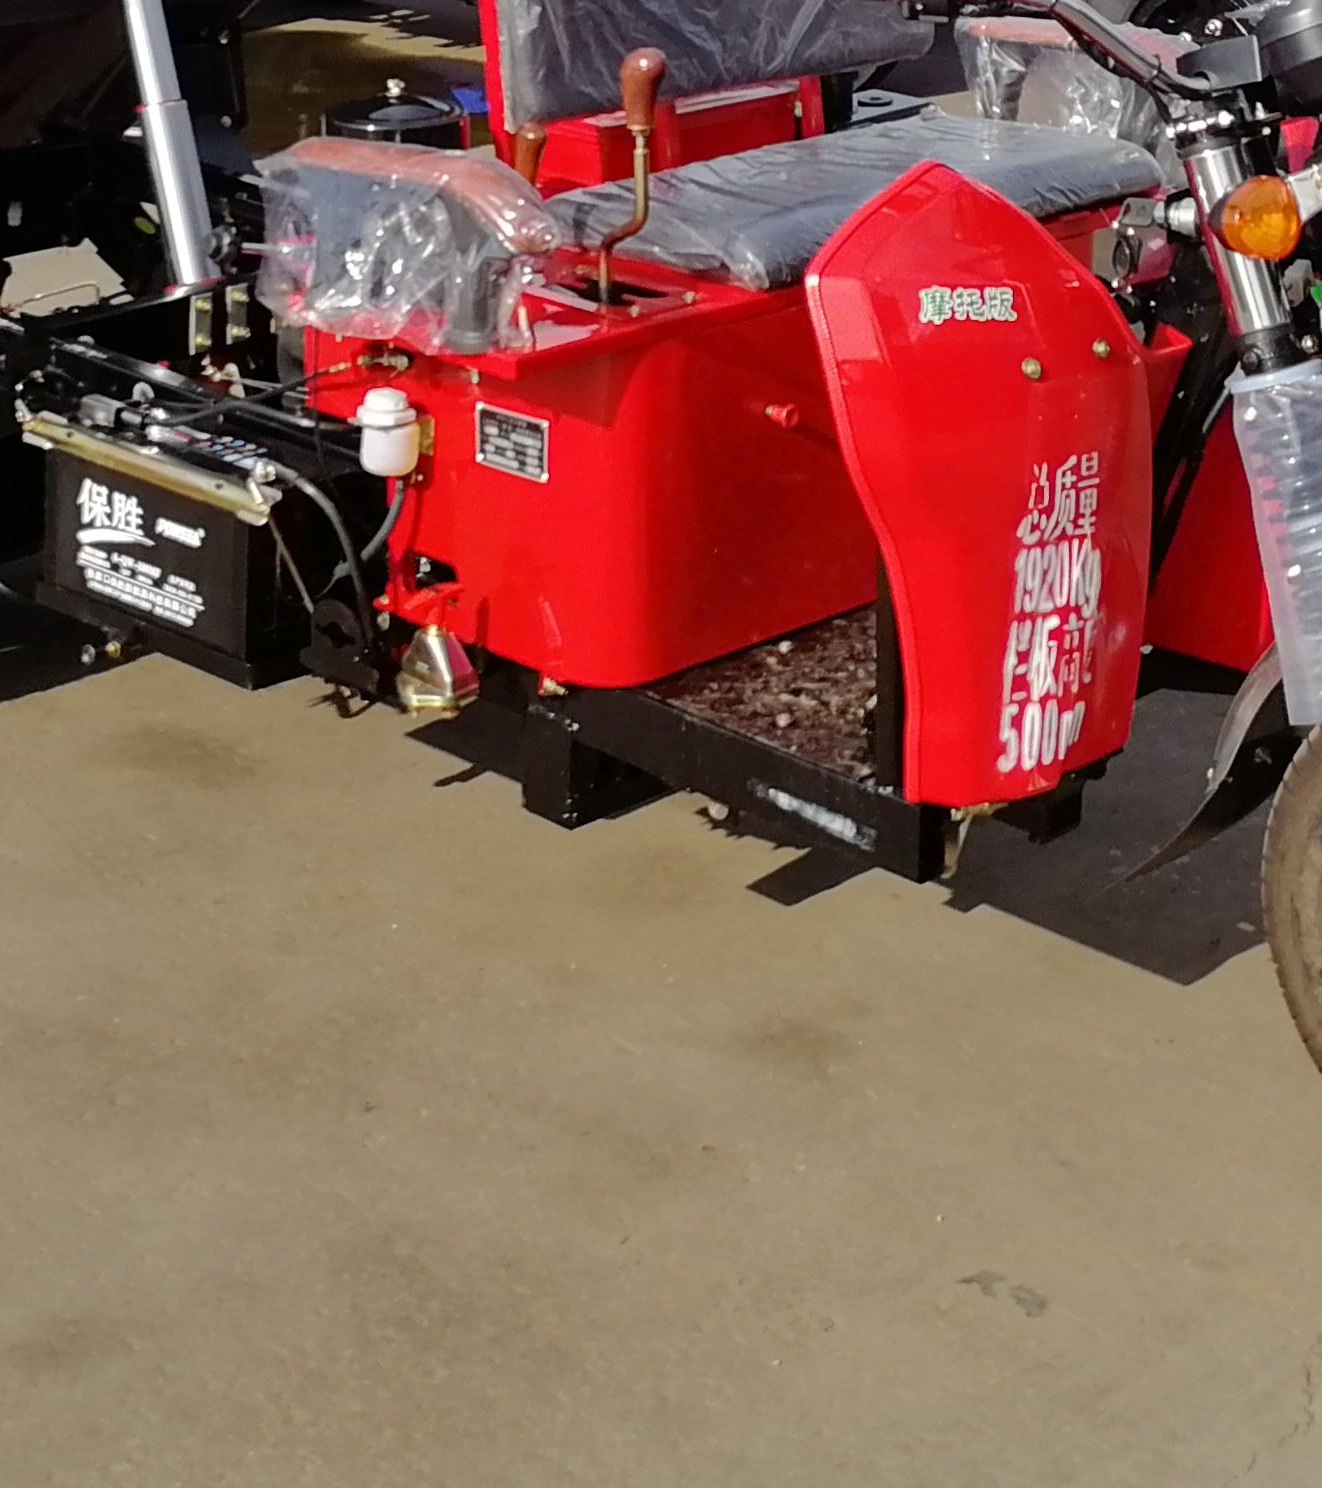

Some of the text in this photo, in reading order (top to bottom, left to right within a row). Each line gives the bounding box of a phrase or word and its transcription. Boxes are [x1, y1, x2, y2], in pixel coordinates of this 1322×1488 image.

[918, 285, 1018, 325] 摩托版
[77, 477, 144, 536] 保胜
[1016, 451, 1101, 545] 总质量
[1014, 538, 1102, 621] 1920Kg
